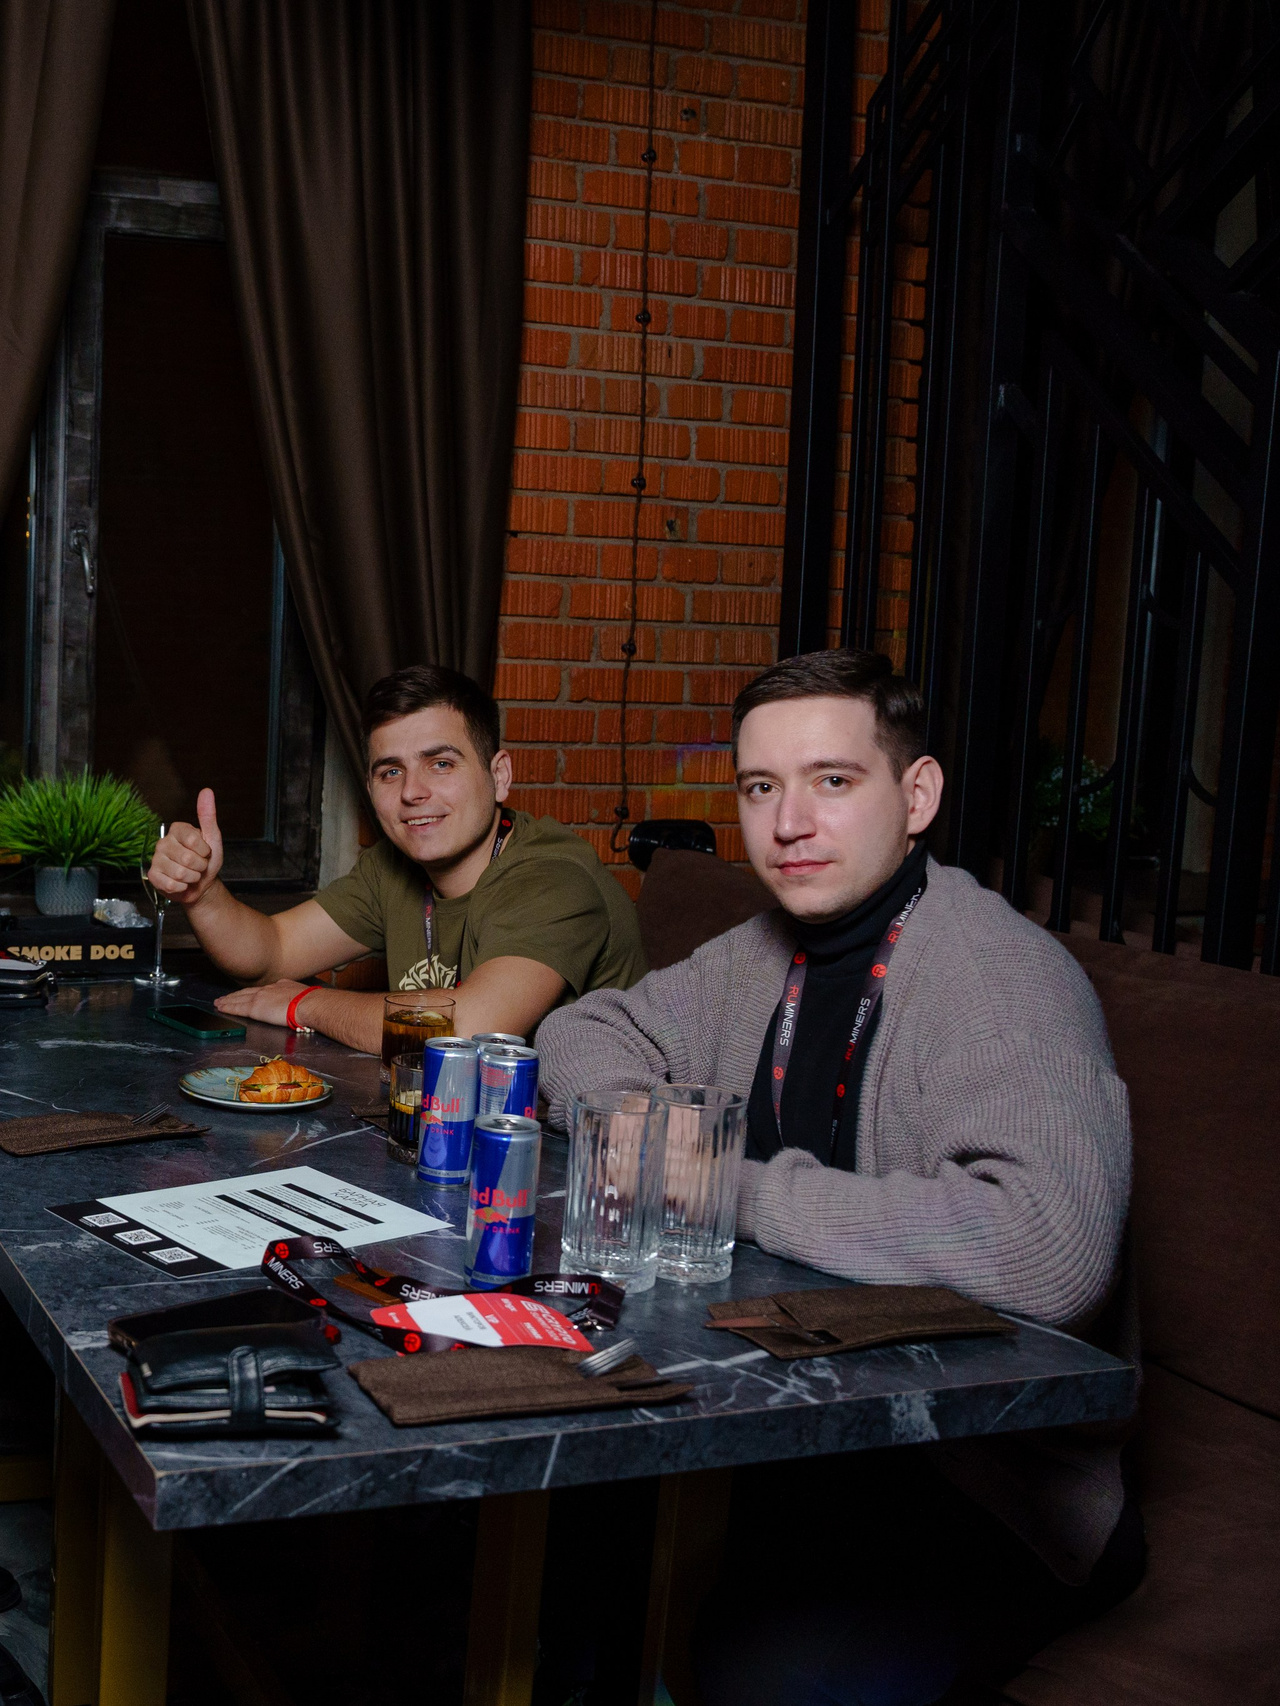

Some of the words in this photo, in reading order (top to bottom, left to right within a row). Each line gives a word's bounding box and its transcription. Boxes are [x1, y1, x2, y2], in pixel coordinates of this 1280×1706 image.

[888, 888, 921, 943] RUMINER
[7, 945, 83, 961] SMOKE
[90, 944, 135, 960] DOG
[780, 985, 800, 1046] RUMINERS
[844, 998, 871, 1061] RUMINERS
[431, 1095, 459, 1113] Bull
[431, 1127, 455, 1136] DRINK
[470, 1186, 490, 1205] ed
[492, 1188, 527, 1209] Bull
[492, 1226, 520, 1234] DRINK
[534, 1280, 602, 1296] UMINERS
